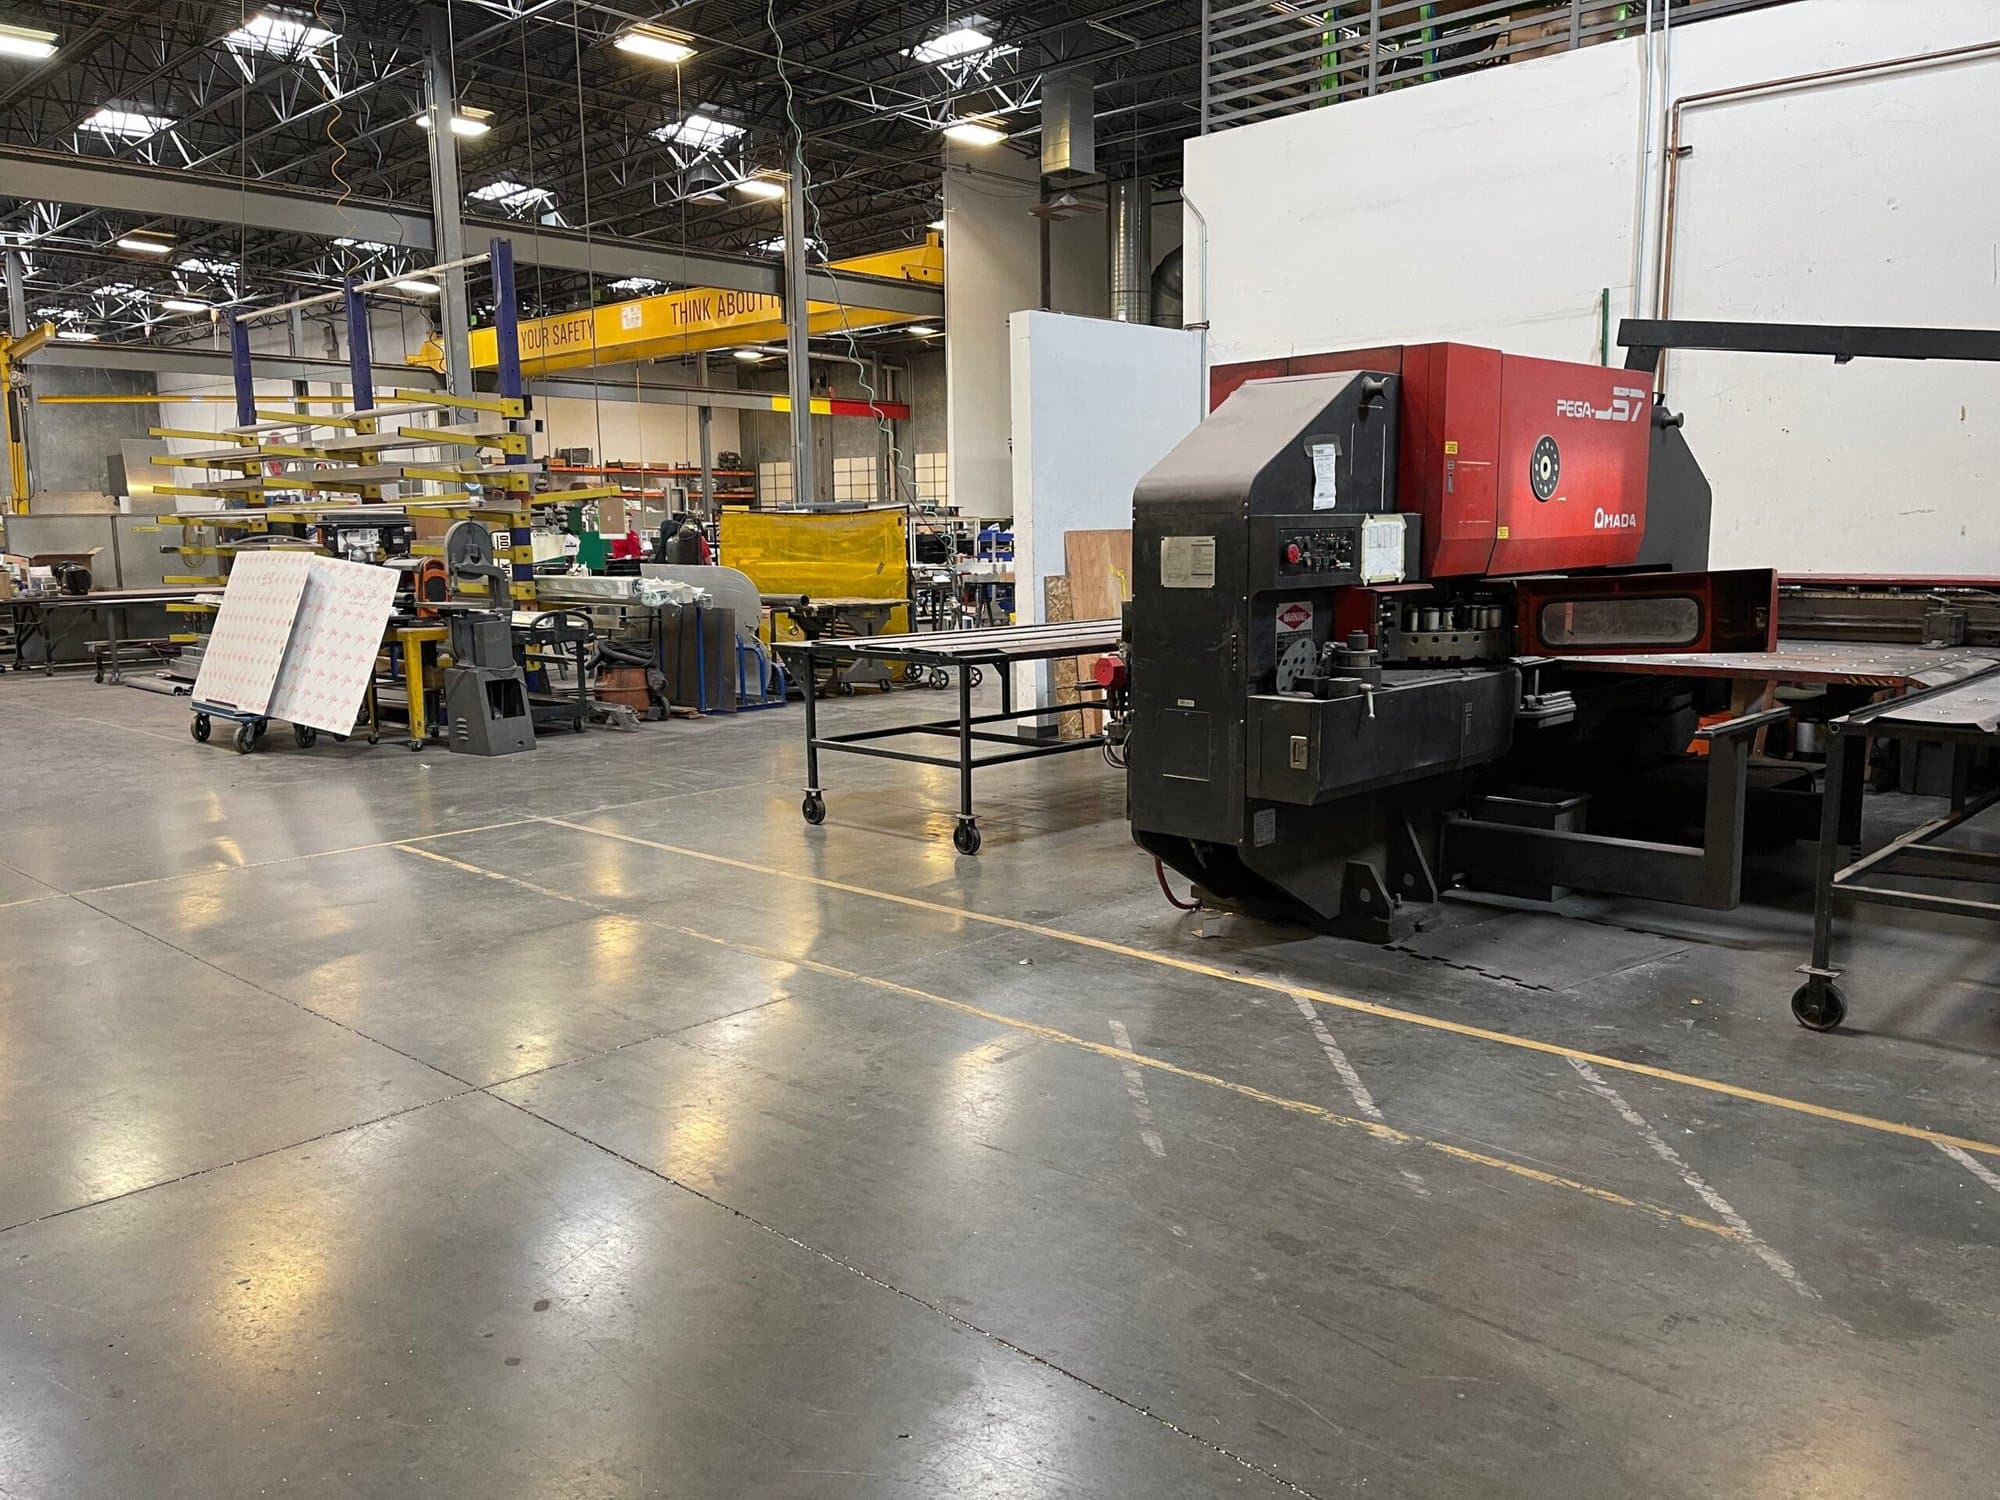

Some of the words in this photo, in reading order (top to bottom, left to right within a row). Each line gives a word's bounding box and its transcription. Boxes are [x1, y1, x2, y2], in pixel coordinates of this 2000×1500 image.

[670, 298, 711, 326] THINK
[717, 292, 763, 318] ABOUT
[521, 327, 549, 352] YOUR
[553, 319, 593, 345] SAFETY
